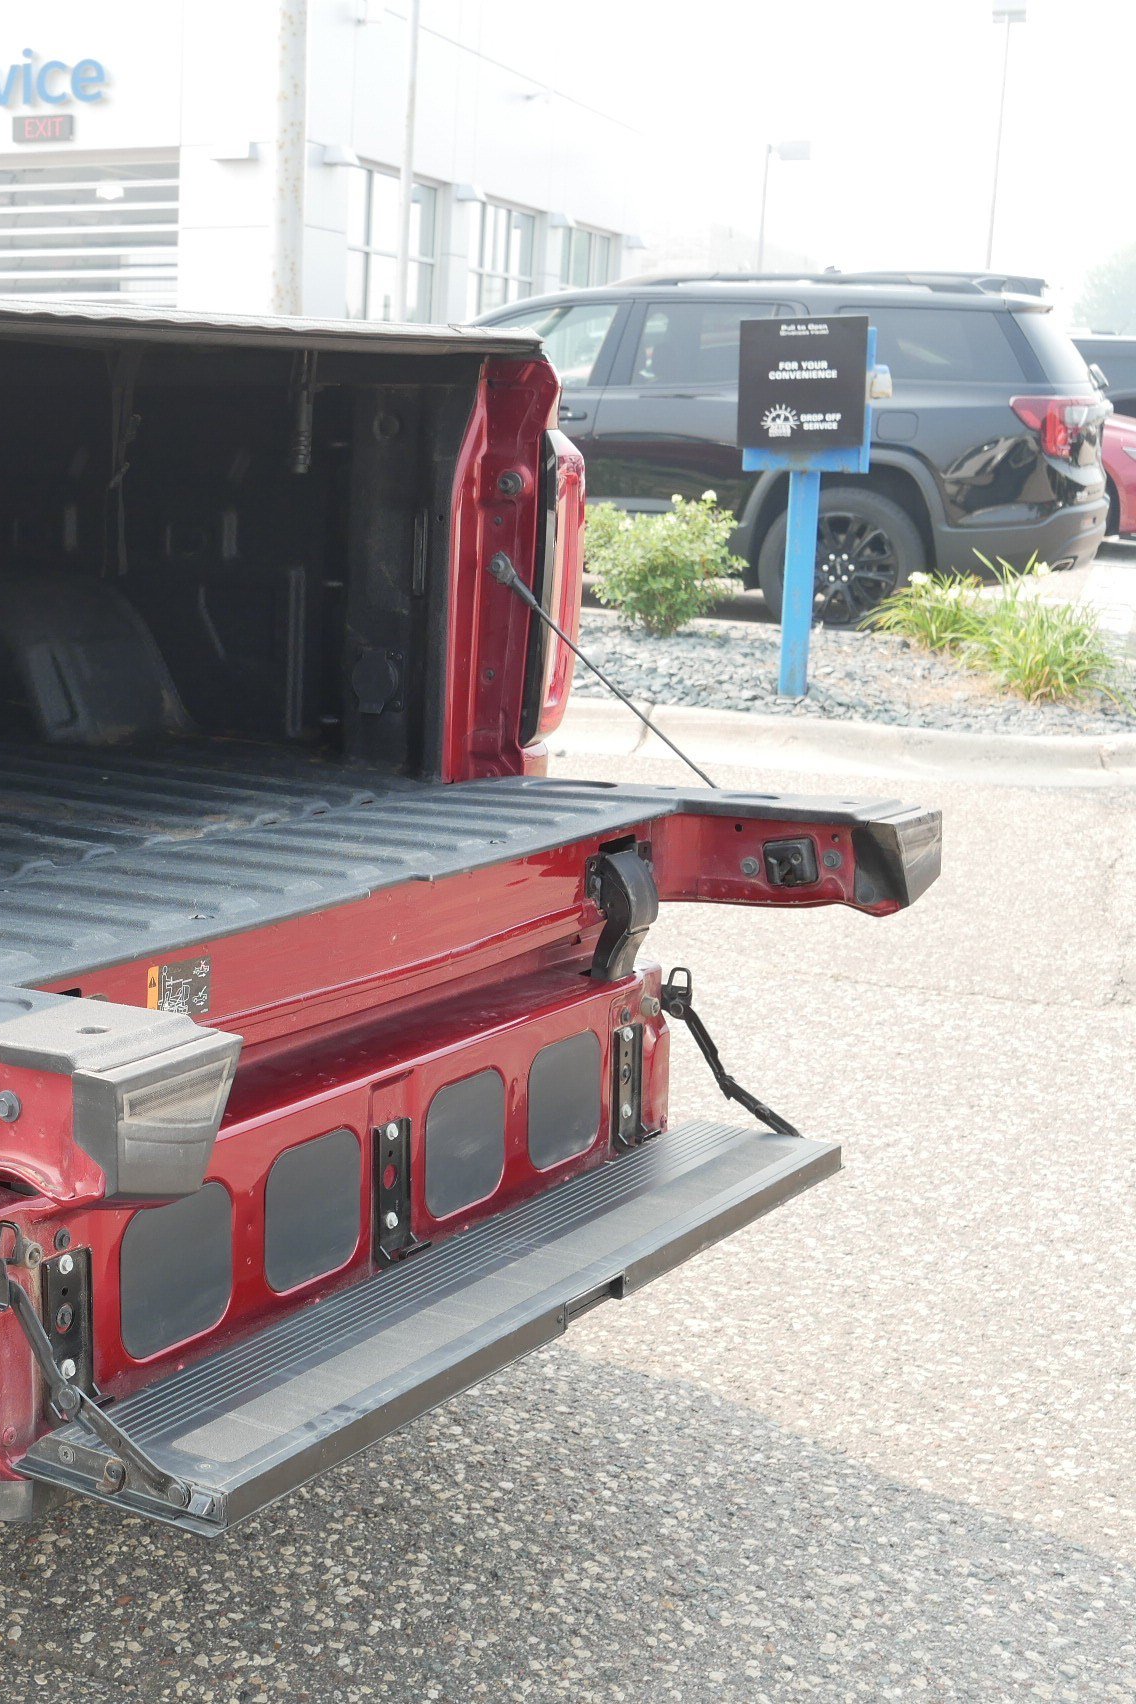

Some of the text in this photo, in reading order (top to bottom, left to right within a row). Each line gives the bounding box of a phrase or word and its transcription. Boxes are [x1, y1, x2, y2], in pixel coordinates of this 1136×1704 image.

[25, 118, 63, 138] EXIT
[778, 360, 828, 371] FOR YOUR
[768, 369, 838, 380] CONVENIENCE
[799, 413, 842, 422] DROP OFF
[803, 421, 838, 430] SERVICE
